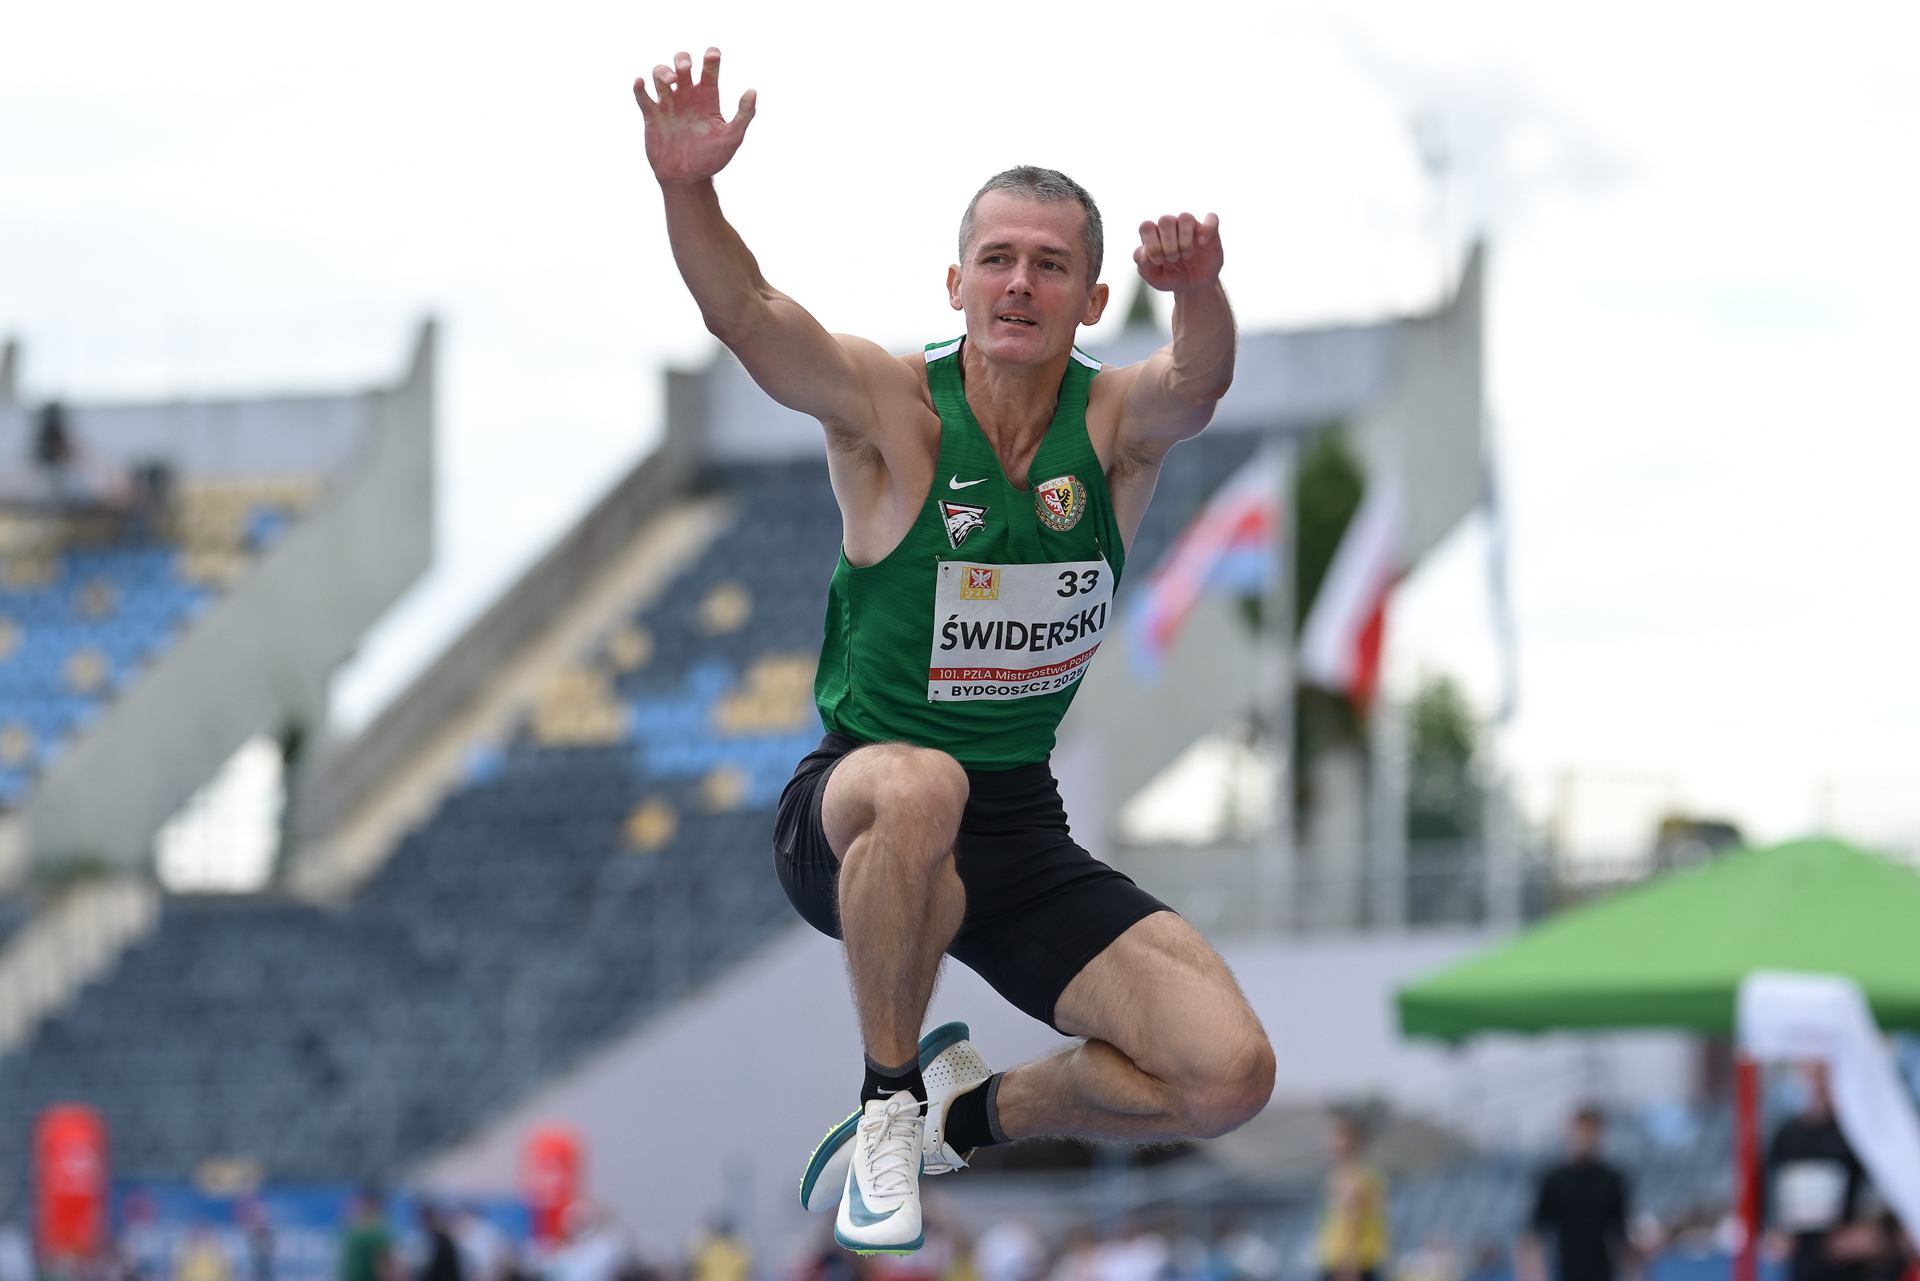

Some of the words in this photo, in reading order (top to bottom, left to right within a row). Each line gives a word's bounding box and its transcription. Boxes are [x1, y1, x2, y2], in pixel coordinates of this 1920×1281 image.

[963, 589, 997, 599] PZLA
[1056, 569, 1100, 598] 33
[939, 601, 1107, 652] ŚWIDERSKI
[939, 669, 960, 680] 101.
[963, 669, 992, 680] PZLA
[995, 664, 1067, 681] Mistrzostwa
[951, 680, 1051, 697] BYDGOSZCZ
[1053, 665, 1084, 689] 2025
